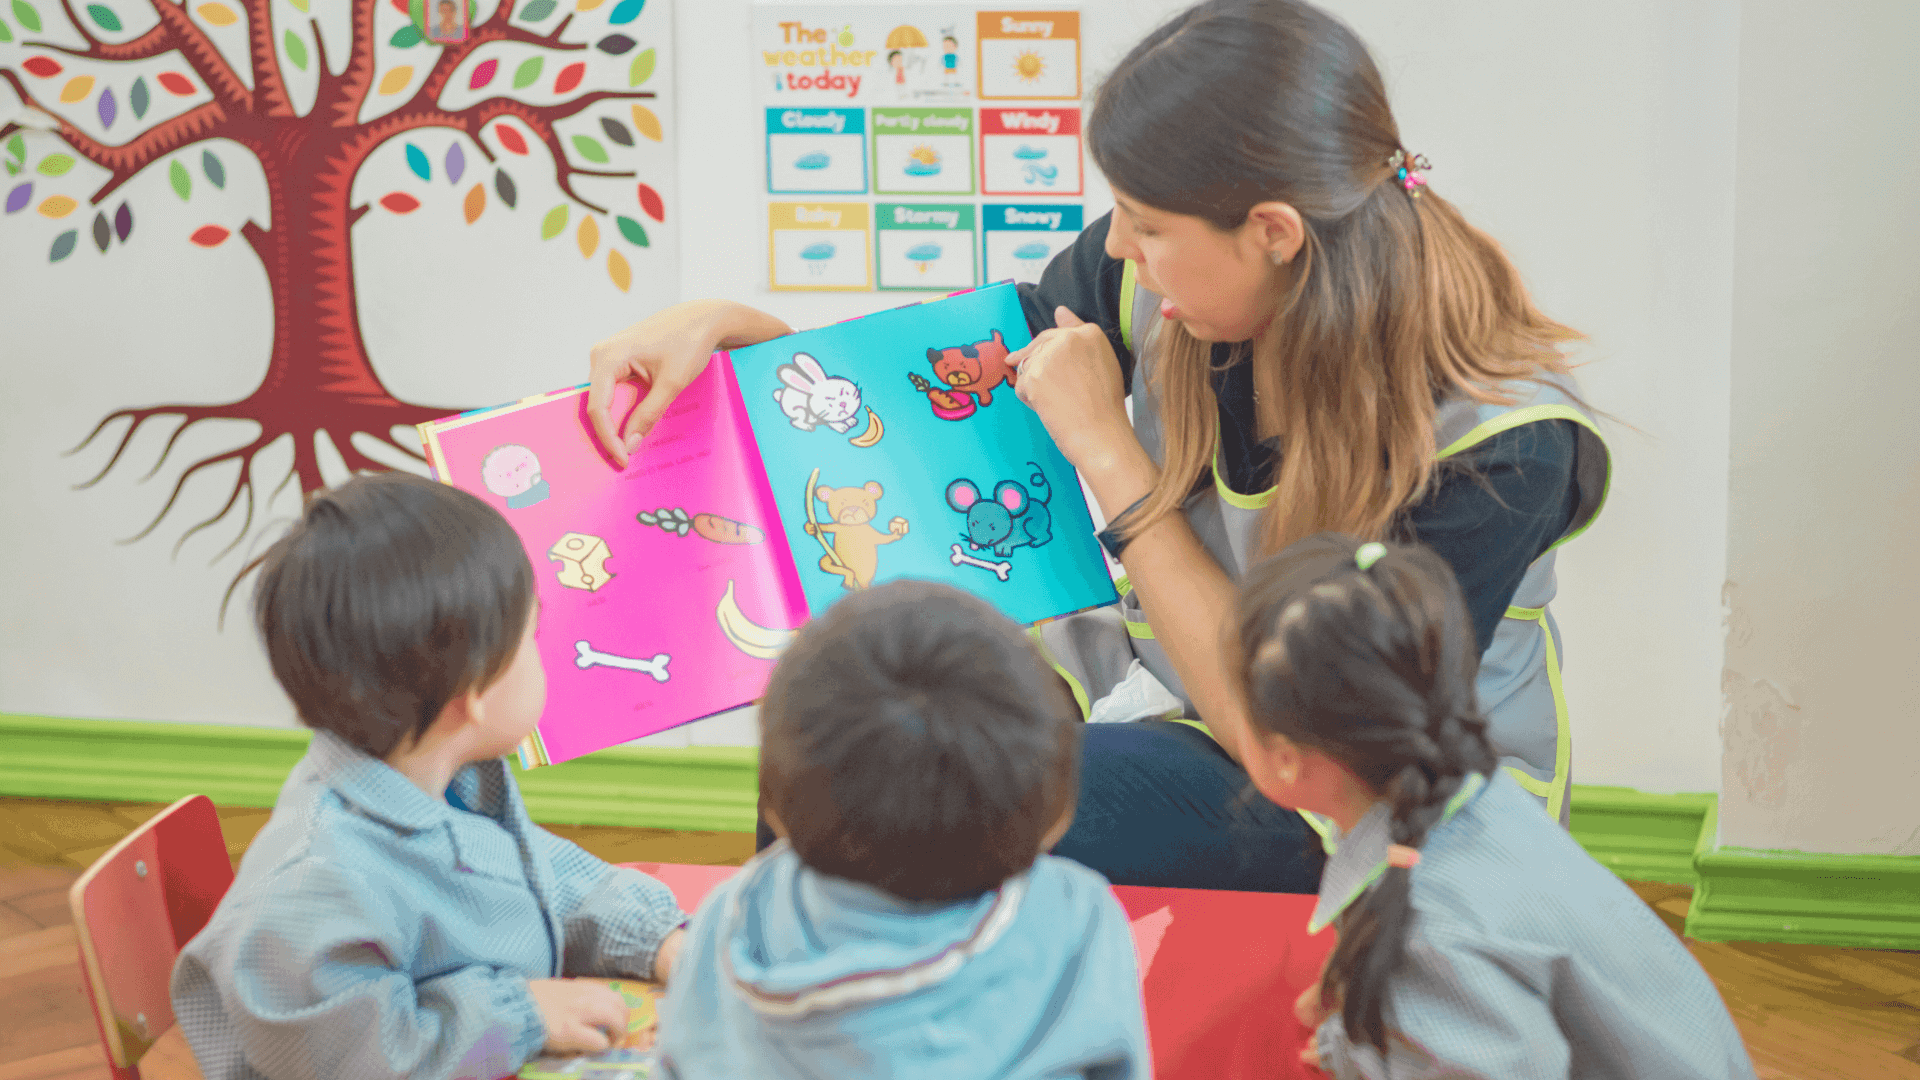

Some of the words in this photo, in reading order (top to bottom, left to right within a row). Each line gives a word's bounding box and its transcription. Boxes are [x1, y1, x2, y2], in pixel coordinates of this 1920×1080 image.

[778, 22, 827, 44] The
[1001, 16, 1054, 37] Sunny
[762, 43, 877, 67] weather
[786, 69, 862, 98] today
[781, 111, 846, 132] Cloudy
[1001, 112, 1061, 133] Windy
[893, 206, 960, 229] Stormy
[1004, 206, 1063, 230] Snowy
